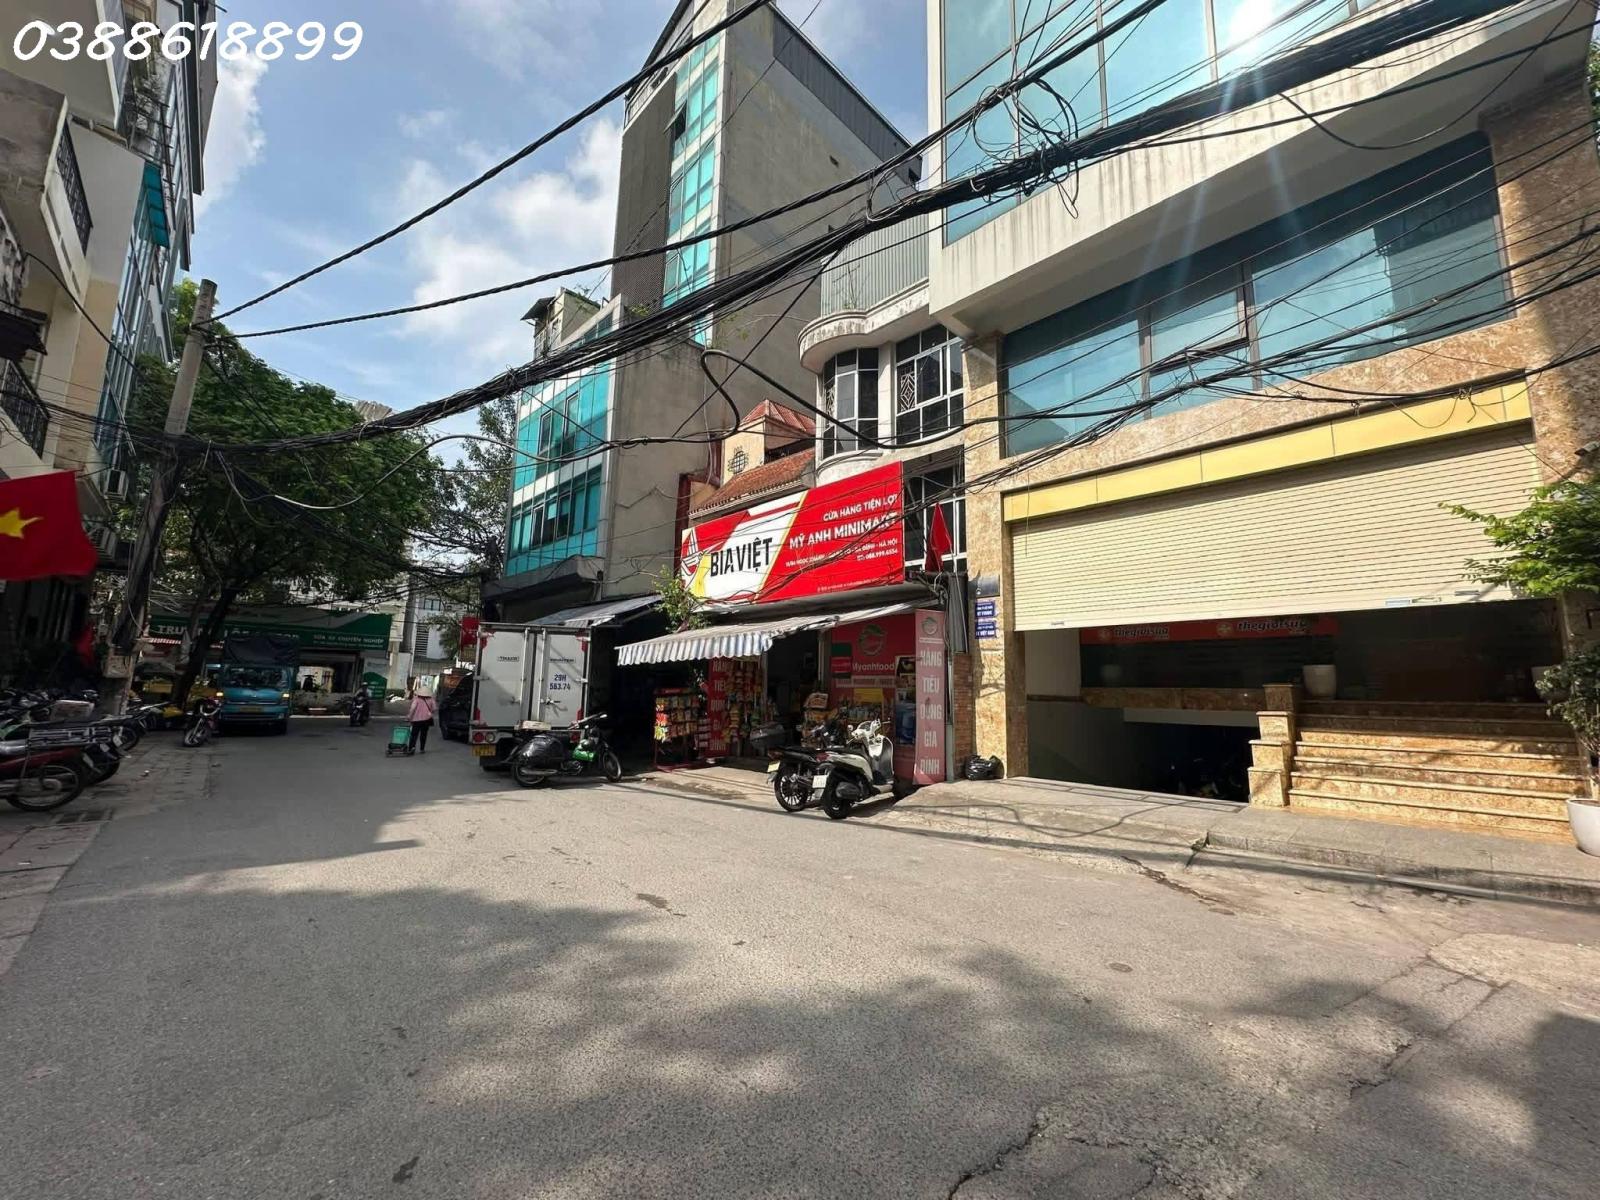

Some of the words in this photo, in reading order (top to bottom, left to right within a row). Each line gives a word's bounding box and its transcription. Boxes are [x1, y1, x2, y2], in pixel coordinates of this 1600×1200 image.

[840, 504, 862, 517] HÀNG
[864, 499, 881, 511] TIỆN
[789, 533, 805, 549] MỸ
[807, 529, 832, 546] ANH
[924, 730, 937, 748] GIA
